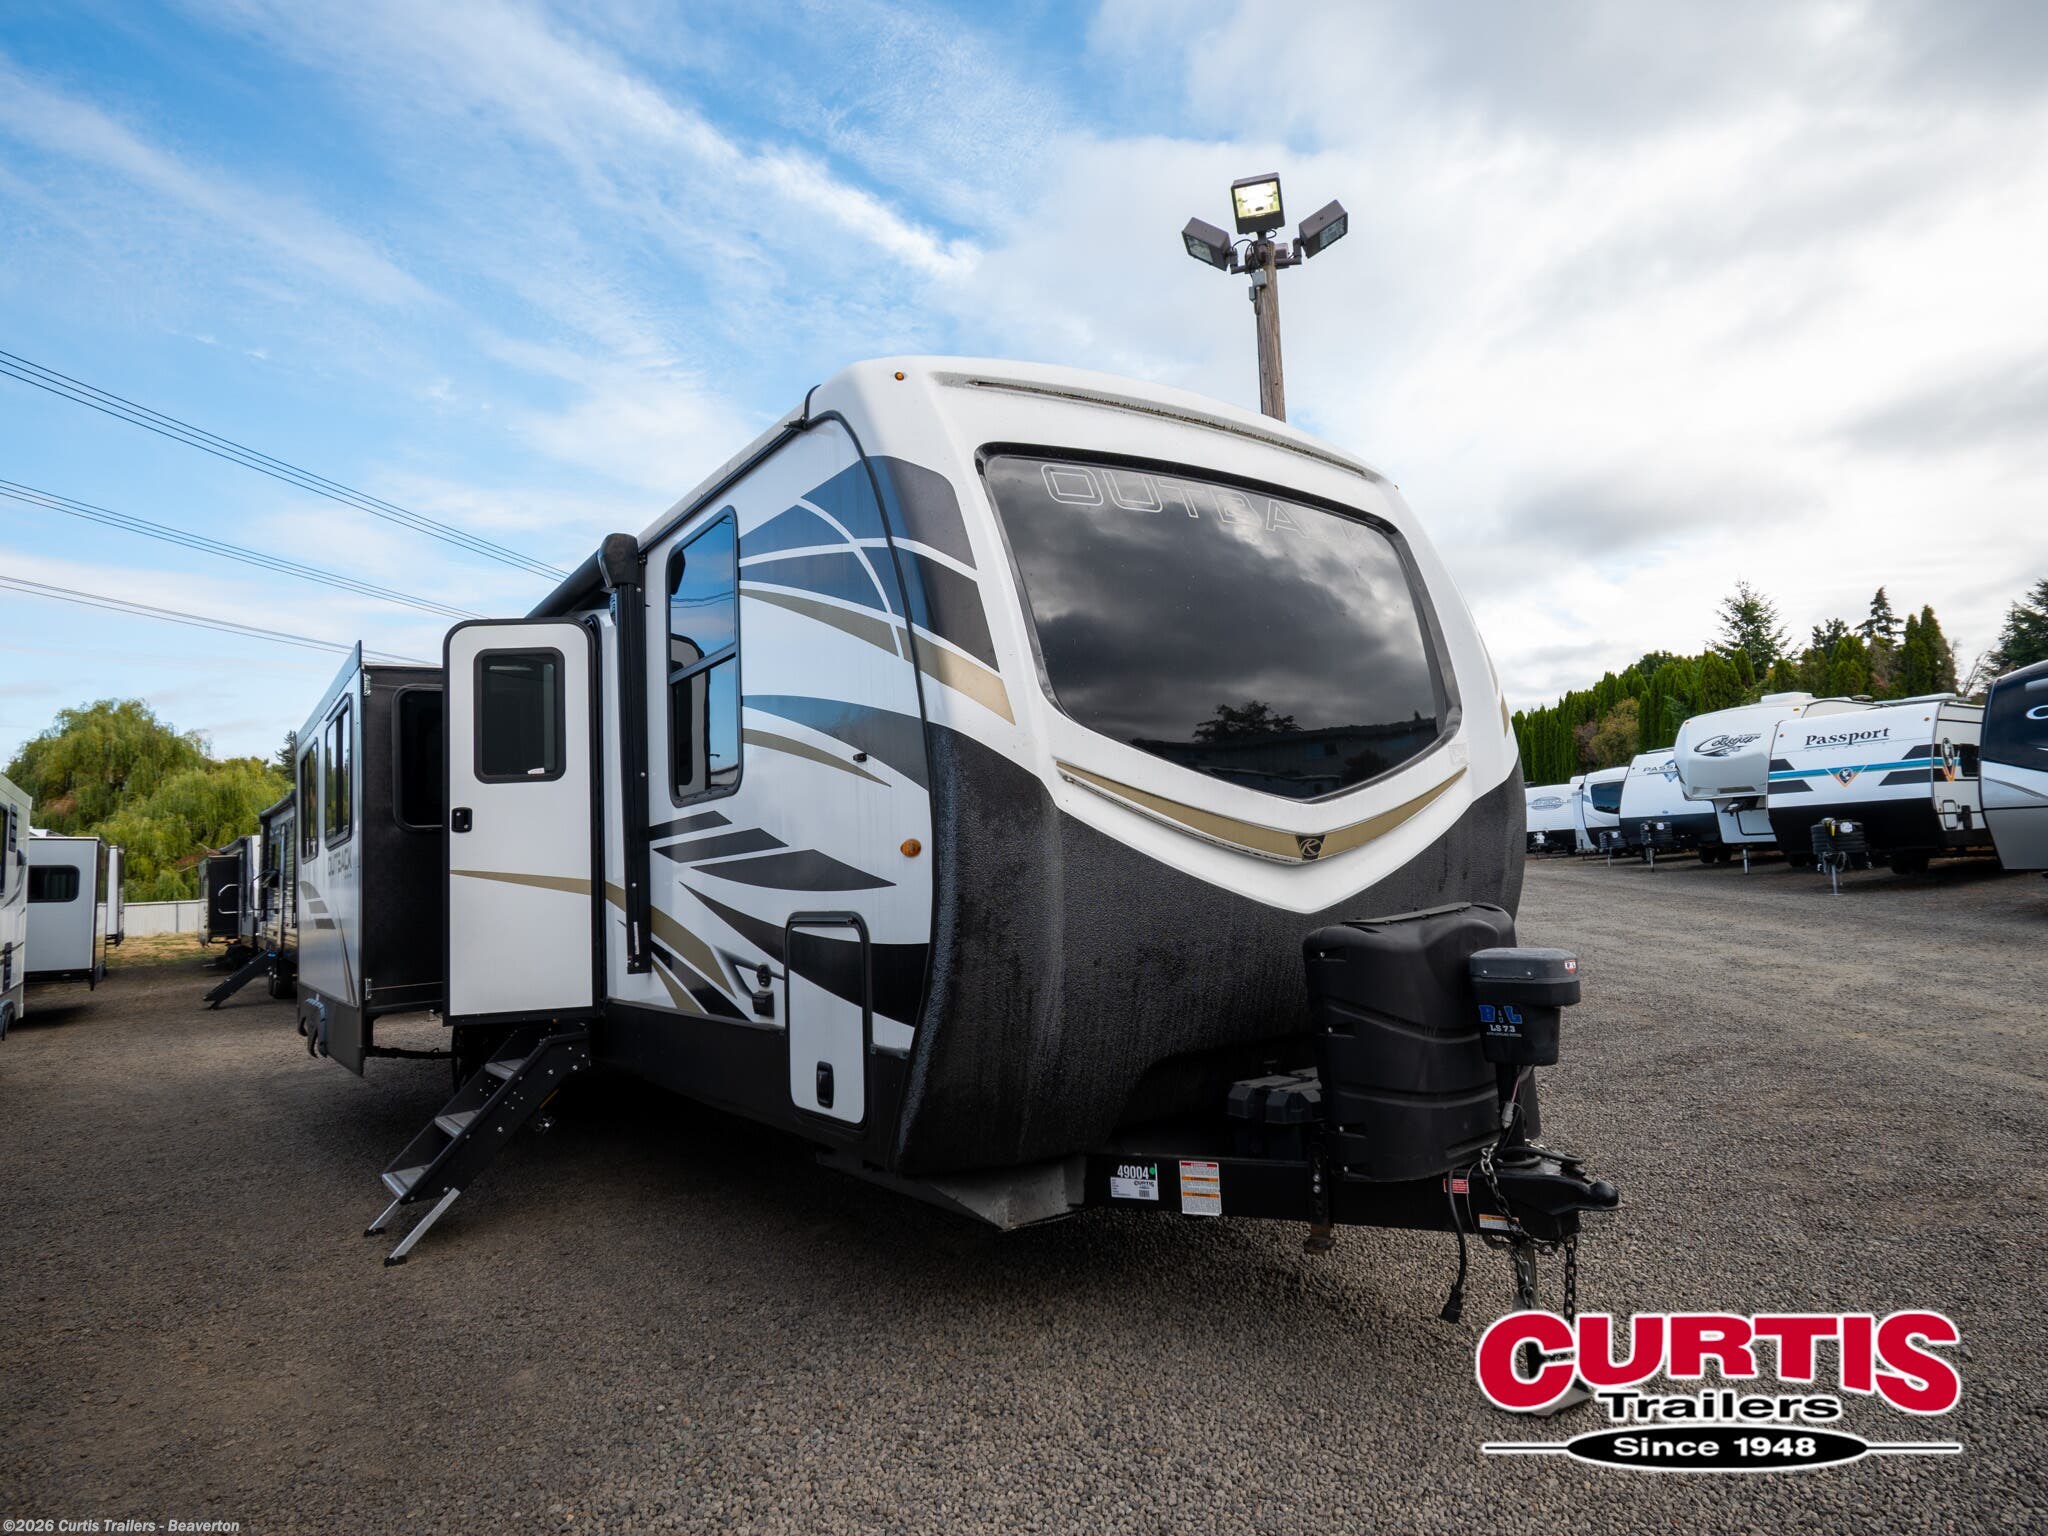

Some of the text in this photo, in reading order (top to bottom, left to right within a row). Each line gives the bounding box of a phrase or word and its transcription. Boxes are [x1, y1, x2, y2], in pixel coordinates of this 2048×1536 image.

[1041, 463, 1367, 540] OUTBA
[1805, 727, 1890, 745] Passport
[1117, 1165, 1149, 1179] 49004
